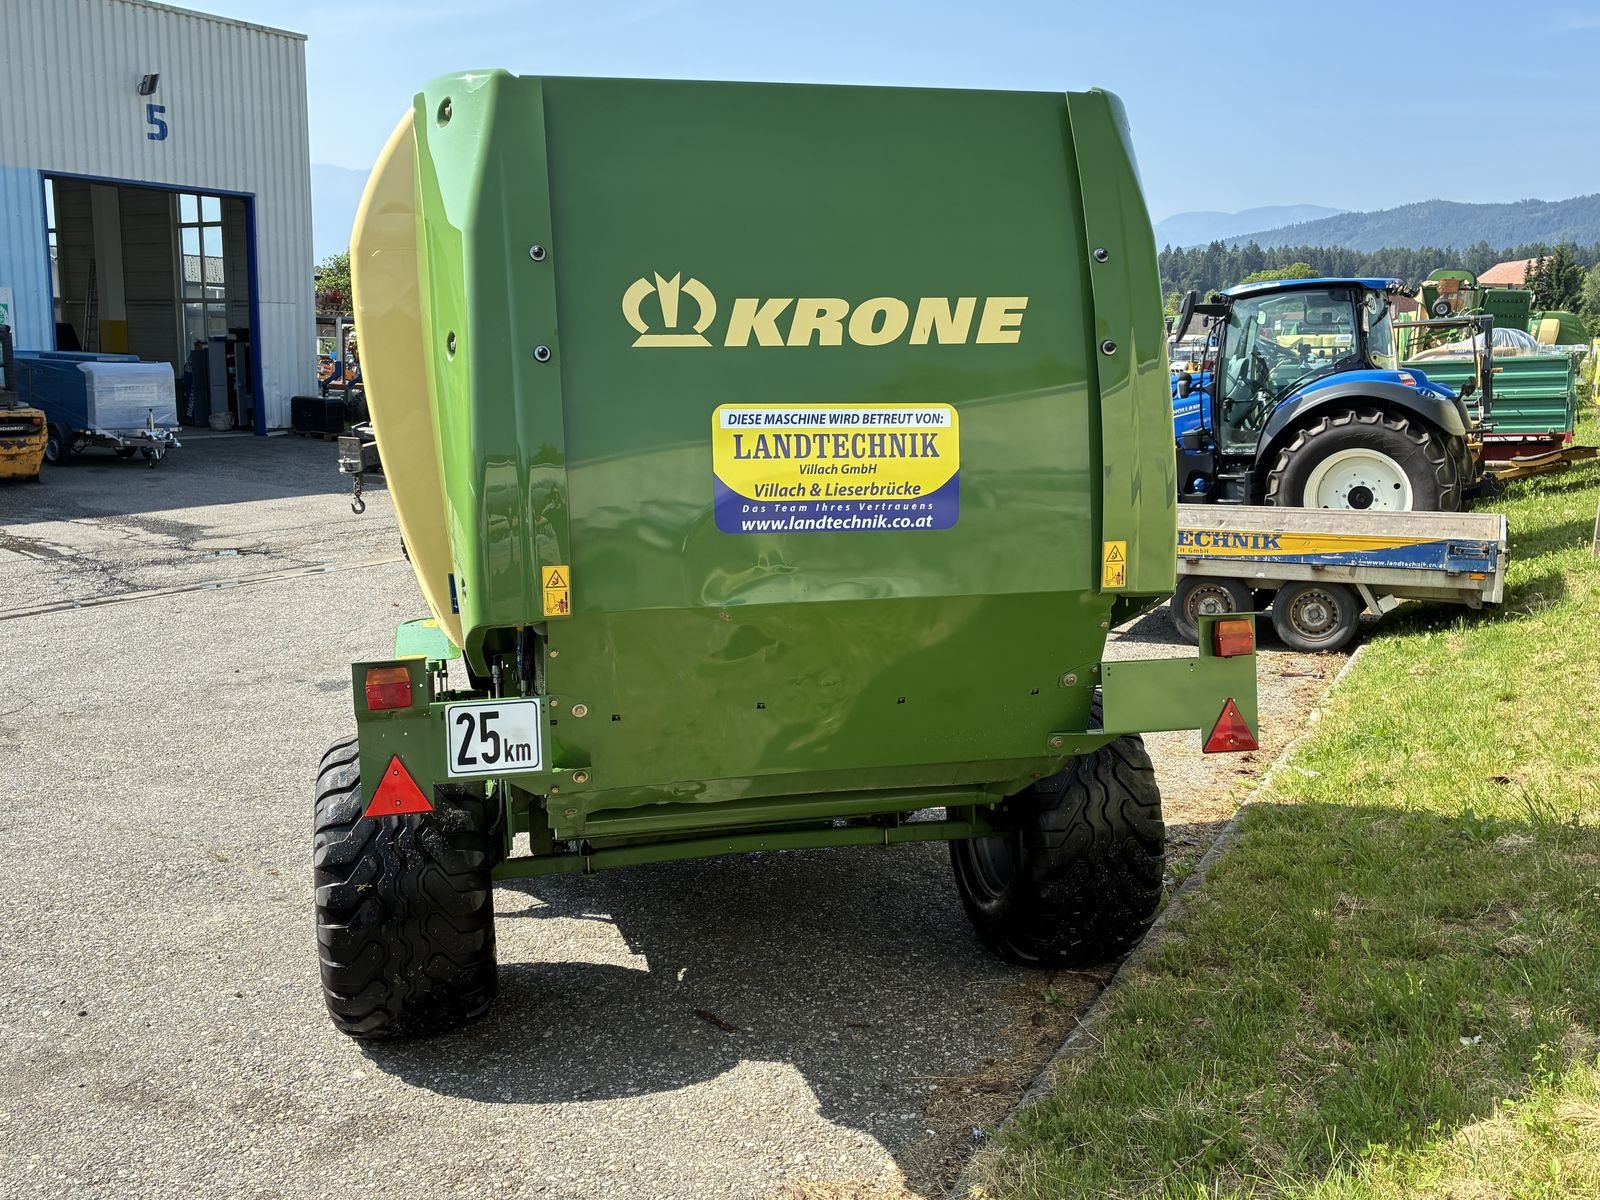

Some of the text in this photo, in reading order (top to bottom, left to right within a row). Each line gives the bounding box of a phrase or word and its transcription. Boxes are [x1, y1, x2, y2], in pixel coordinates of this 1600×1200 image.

[146, 103, 168, 141] 5
[724, 296, 1029, 347] KRONE
[728, 412, 944, 425] DIESE MASCHINE WIRD BETREUT VON:
[733, 432, 940, 460] LANDTECHNIK
[799, 463, 877, 475] Villach GmbH
[754, 482, 921, 498] Villach & Lieserbrücke
[742, 502, 933, 513] Das Team Ihres Vertrauens
[741, 514, 933, 531] www.landtechnik.co.at
[1178, 530, 1281, 550] ECHNIK
